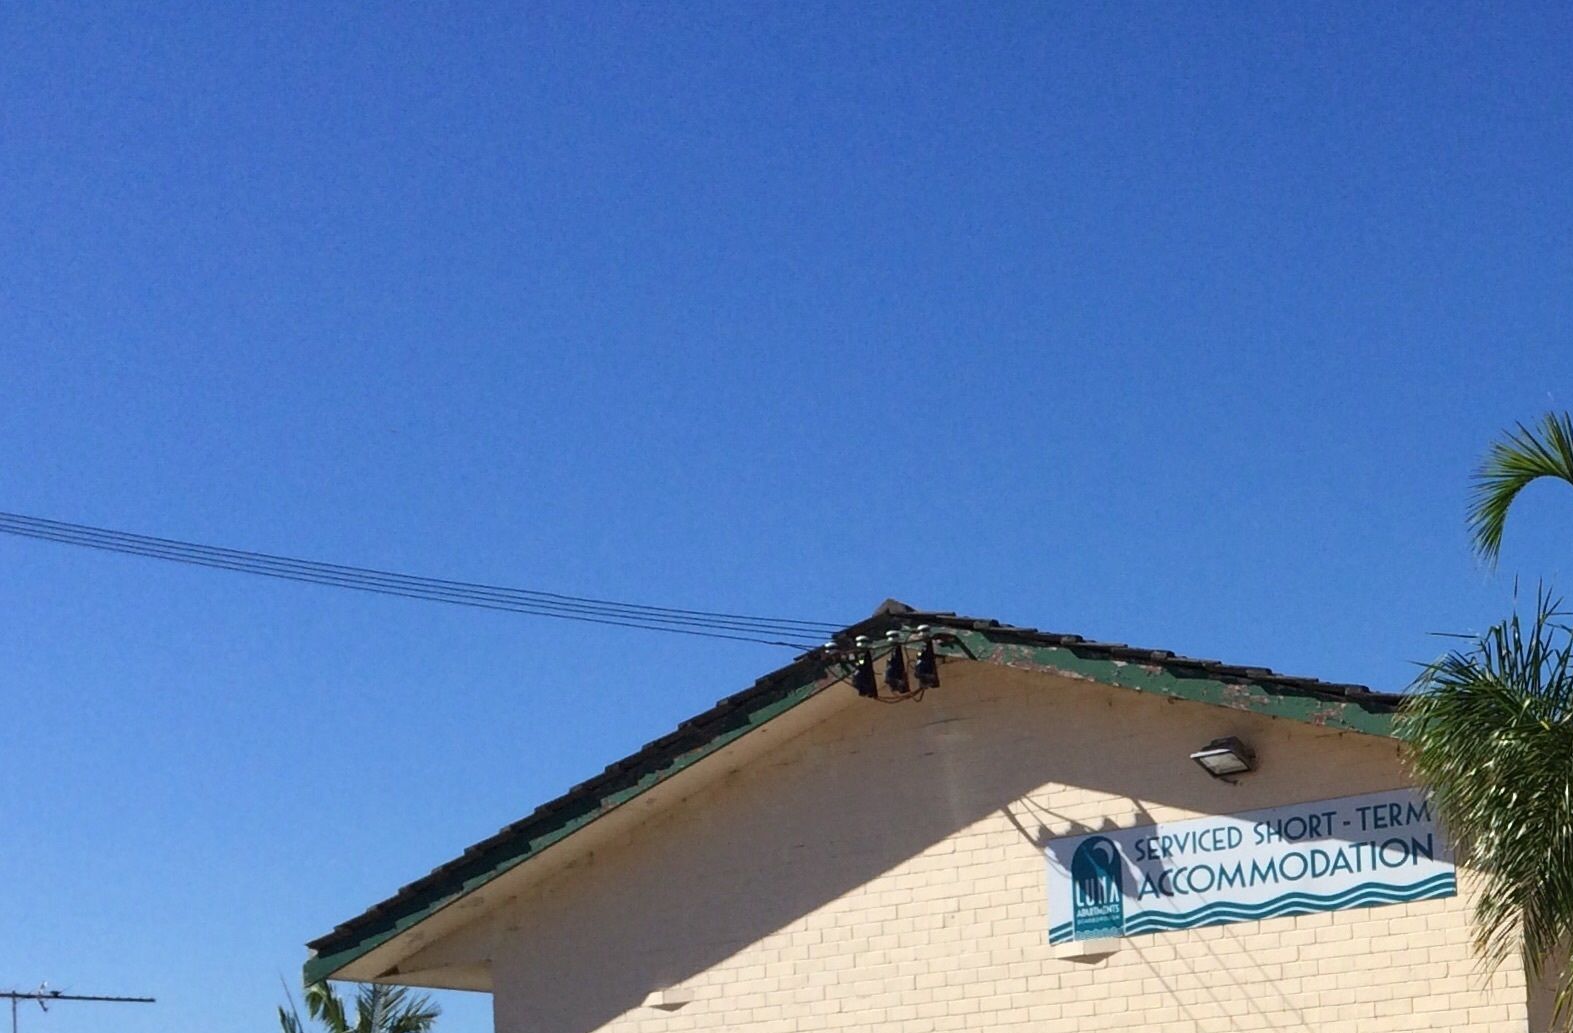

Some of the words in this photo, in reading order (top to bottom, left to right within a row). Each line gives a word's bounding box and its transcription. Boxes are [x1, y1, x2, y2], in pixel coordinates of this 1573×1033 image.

[1135, 826, 1243, 862] SERVICED
[1137, 833, 1434, 901] ACCOMMODATION
[1076, 876, 1120, 907] LUNA
